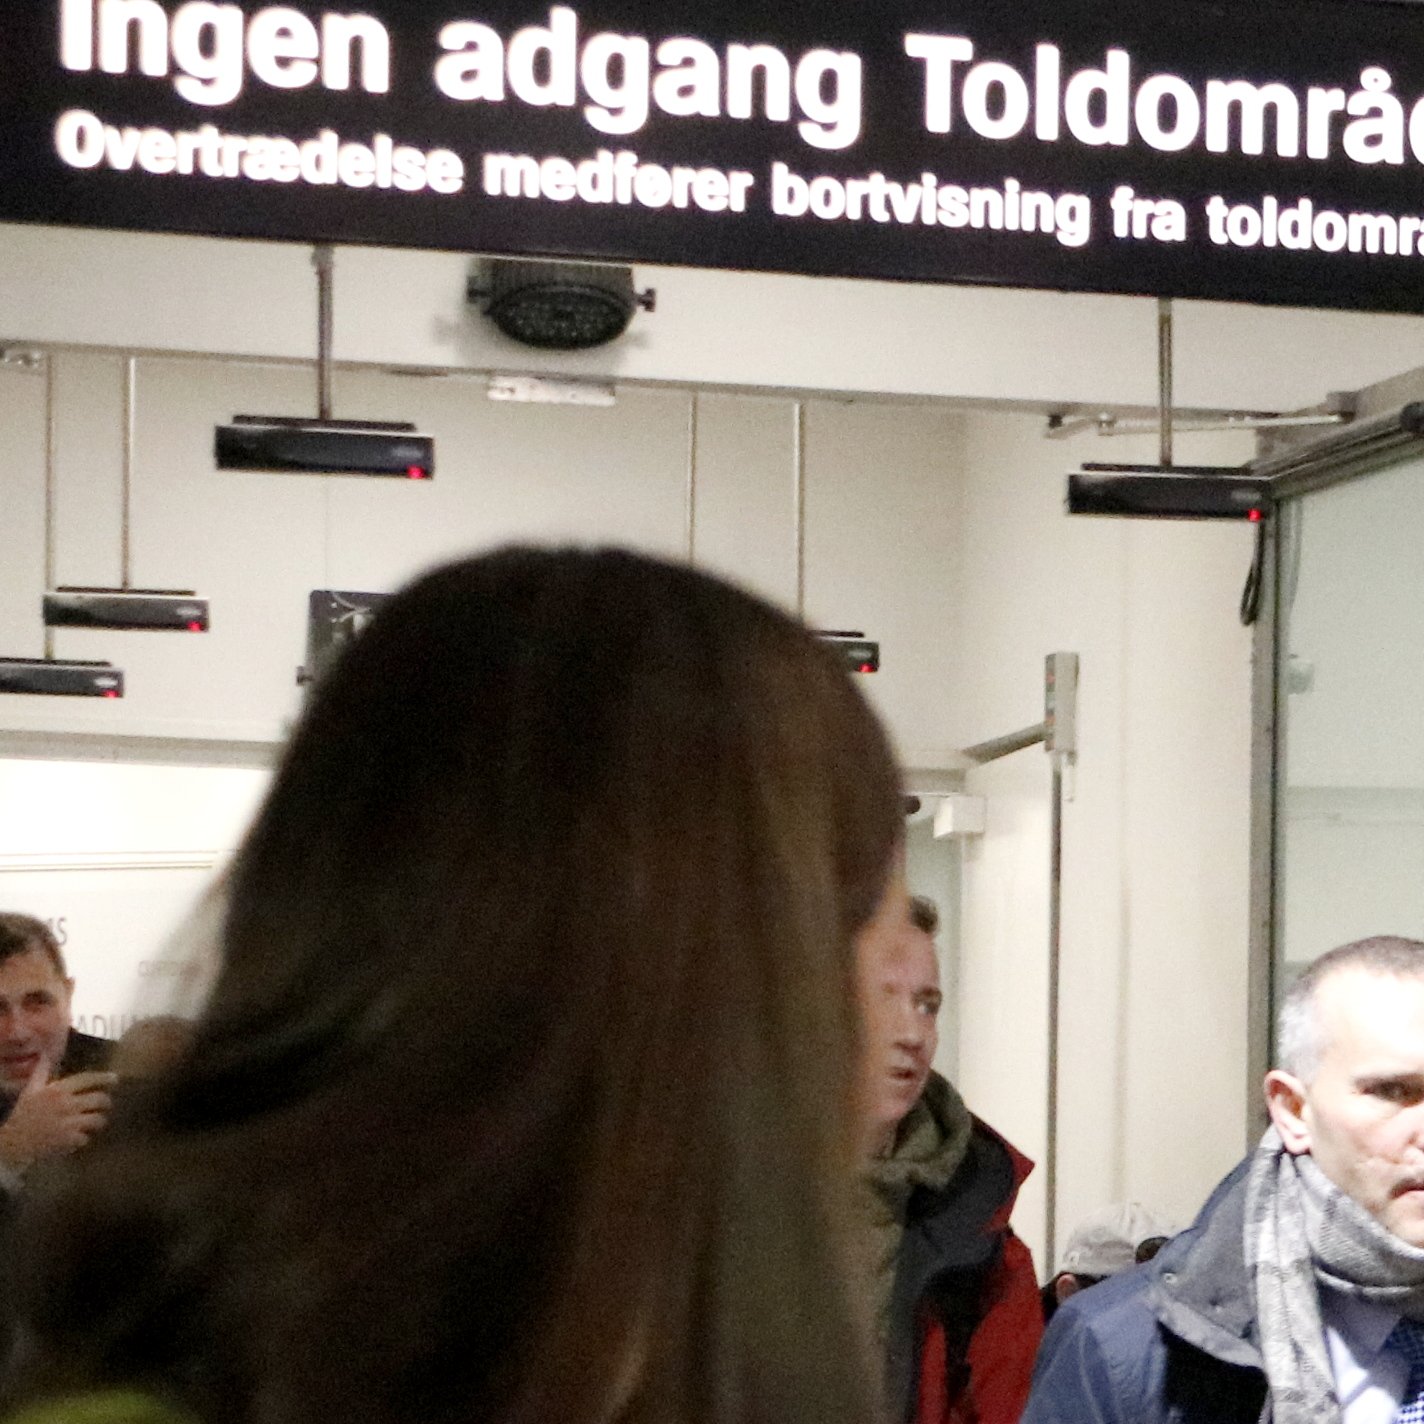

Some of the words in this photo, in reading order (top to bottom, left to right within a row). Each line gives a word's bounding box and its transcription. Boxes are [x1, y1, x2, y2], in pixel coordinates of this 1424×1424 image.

[61, 0, 390, 107] Ingen
[434, 6, 862, 150] adgang
[56, 110, 465, 194] Overtrædelse
[483, 149, 755, 213] medfører
[771, 162, 1091, 248] bortvisning
[1109, 185, 1187, 242] fra
